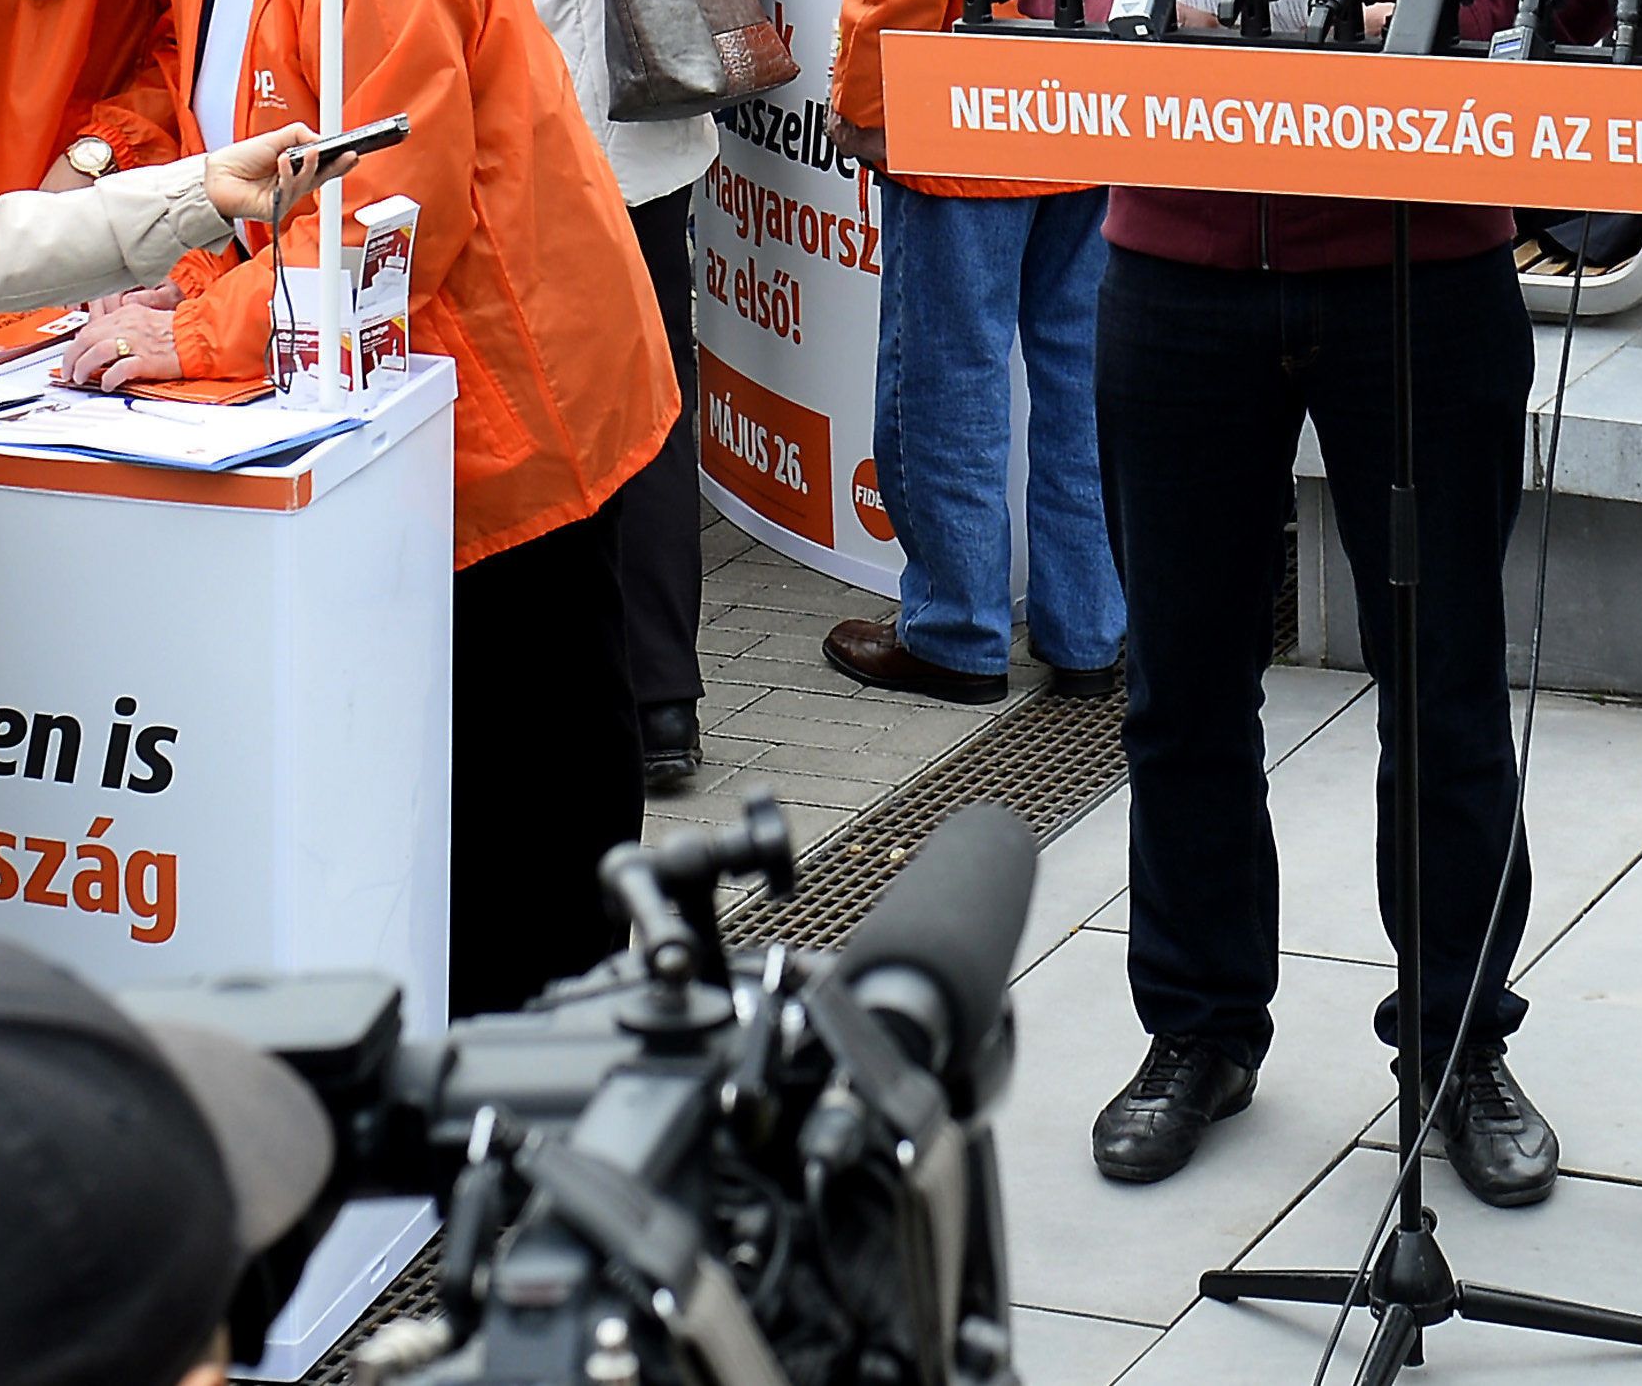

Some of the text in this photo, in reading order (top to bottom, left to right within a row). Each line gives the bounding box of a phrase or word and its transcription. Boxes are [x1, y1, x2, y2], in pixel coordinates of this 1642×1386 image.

[950, 79, 1131, 138] NEKÜNK
[1144, 95, 1515, 159] MAGYARORSZÁG
[1530, 115, 1592, 162] AZ
[705, 159, 882, 276] Magyarorsz
[707, 247, 802, 345] az első!
[709, 391, 809, 495] MÁJUS 26.
[855, 483, 886, 512] FIDE
[100, 695, 179, 795] is
